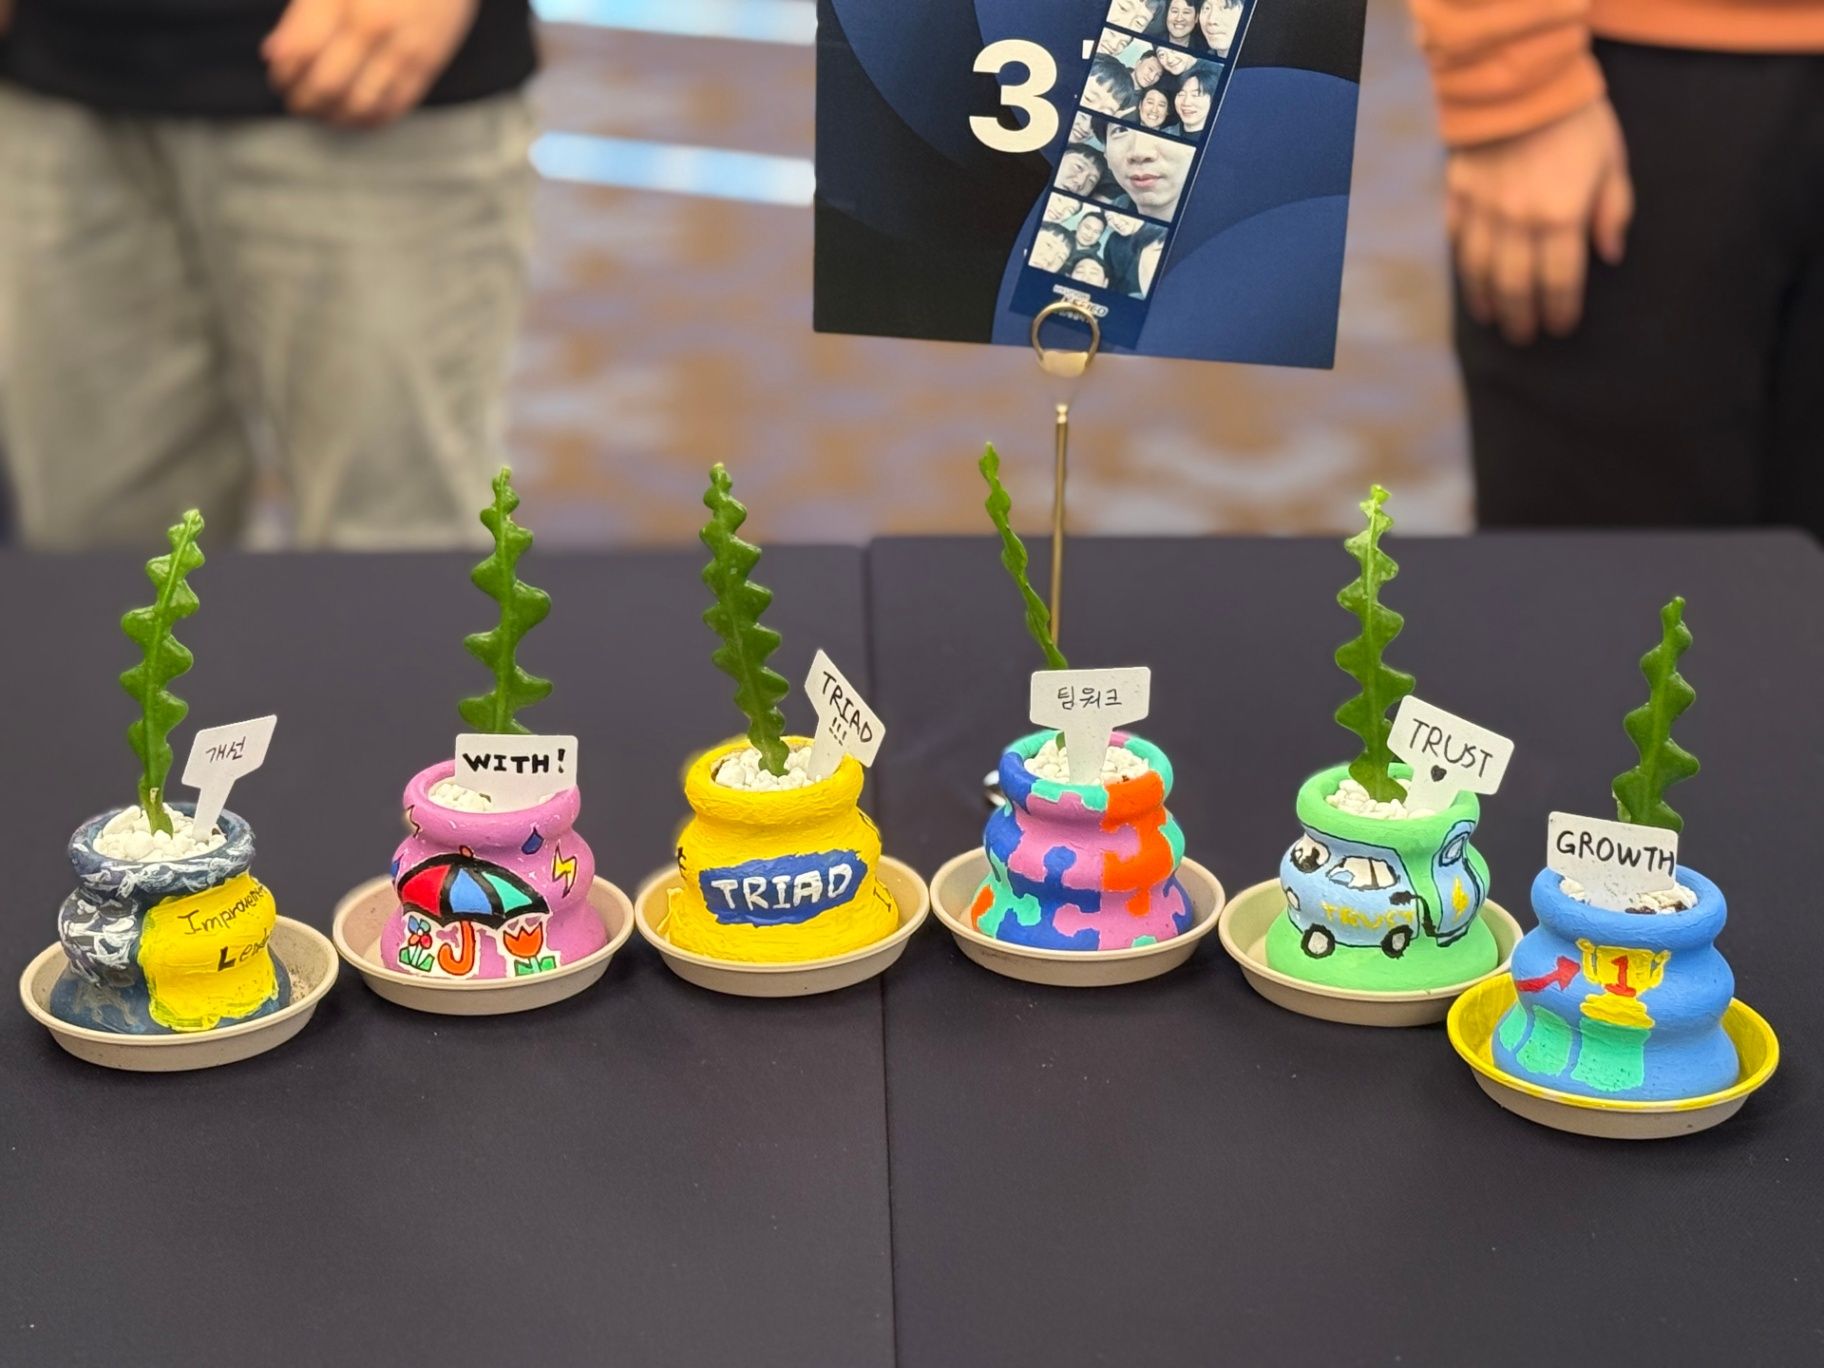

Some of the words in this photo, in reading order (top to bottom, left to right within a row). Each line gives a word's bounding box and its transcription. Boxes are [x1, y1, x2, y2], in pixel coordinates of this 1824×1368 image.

[968, 38, 1095, 153] 3
[822, 670, 873, 743] TRIAD
[1057, 685, 1122, 710] 팀워크
[205, 735, 246, 763] 개선
[462, 748, 566, 774] WITH!
[1410, 717, 1493, 778] TRUST
[1556, 830, 1675, 877] GROWTH
[710, 863, 853, 911] TRIAD
[1605, 954, 1637, 998] 1
